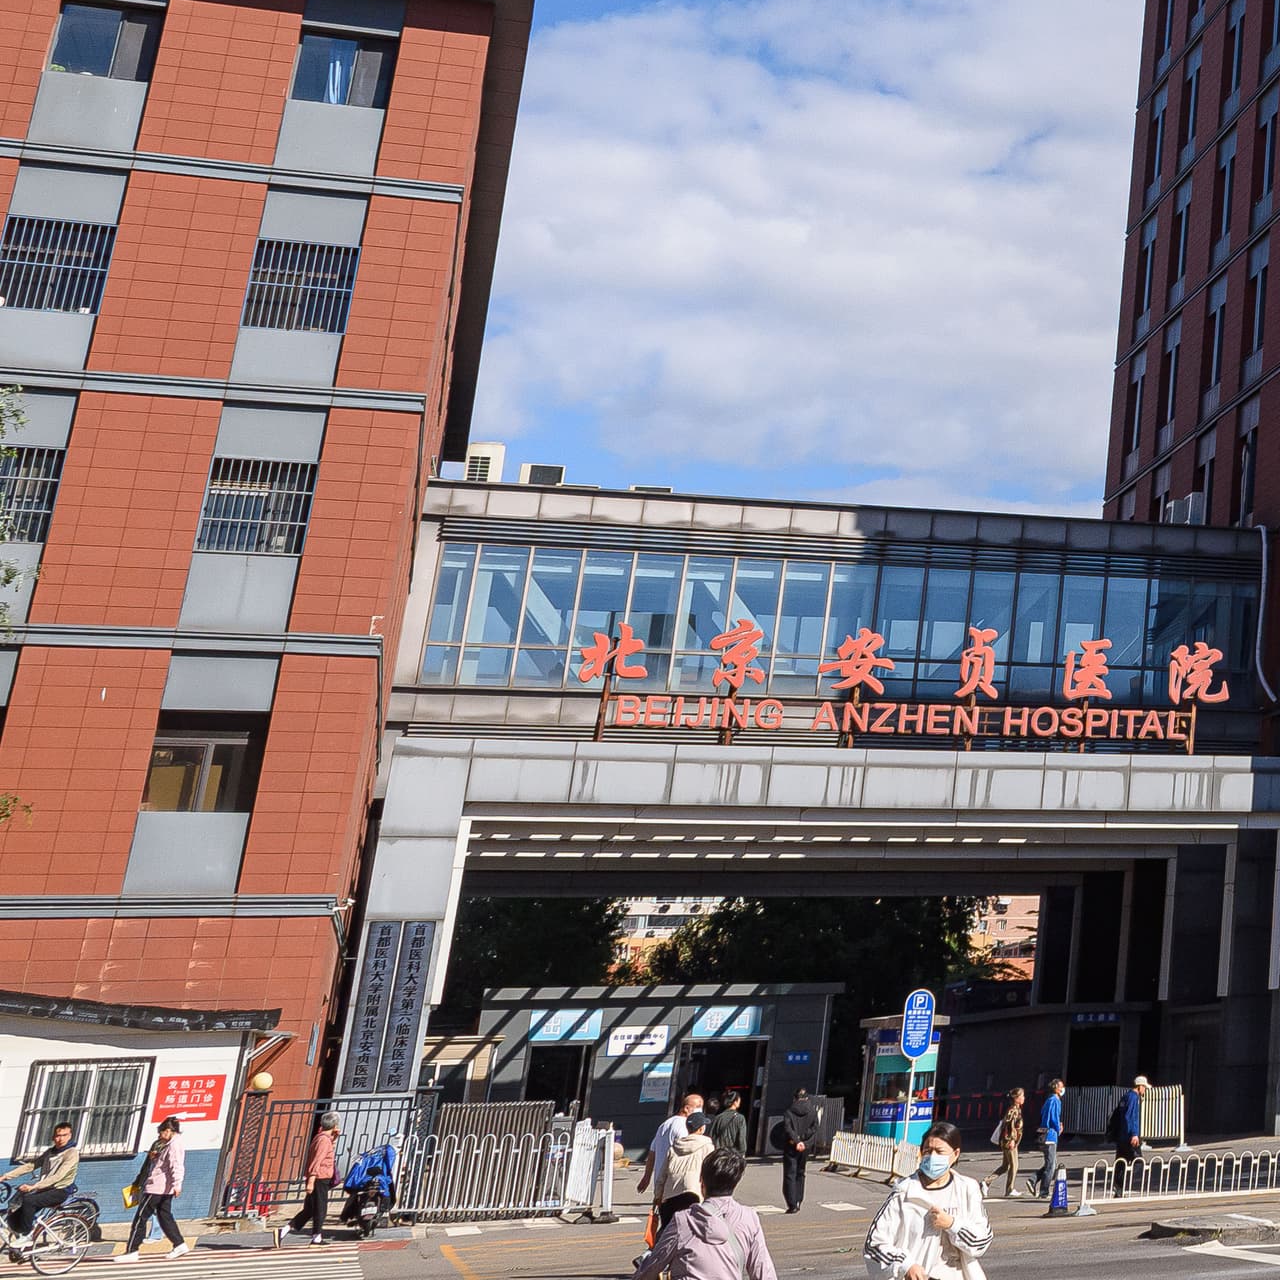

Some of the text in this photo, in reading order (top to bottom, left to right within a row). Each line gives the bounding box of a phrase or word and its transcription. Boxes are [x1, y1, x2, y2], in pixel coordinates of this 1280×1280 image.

[578, 618, 1230, 705] 北京安贞医院
[615, 695, 1187, 740] BEIJING ANZHEN HOSPITAL
[352, 924, 393, 1088] 首都医科大学附属北京安贞医院
[387, 924, 428, 1086] 首都医科大学第六临床医学院
[916, 996, 925, 1008] P
[704, 1011, 751, 1031] 进口
[165, 1094, 214, 1104] 肠道门诊
[168, 1079, 216, 1089] 发热门诊
